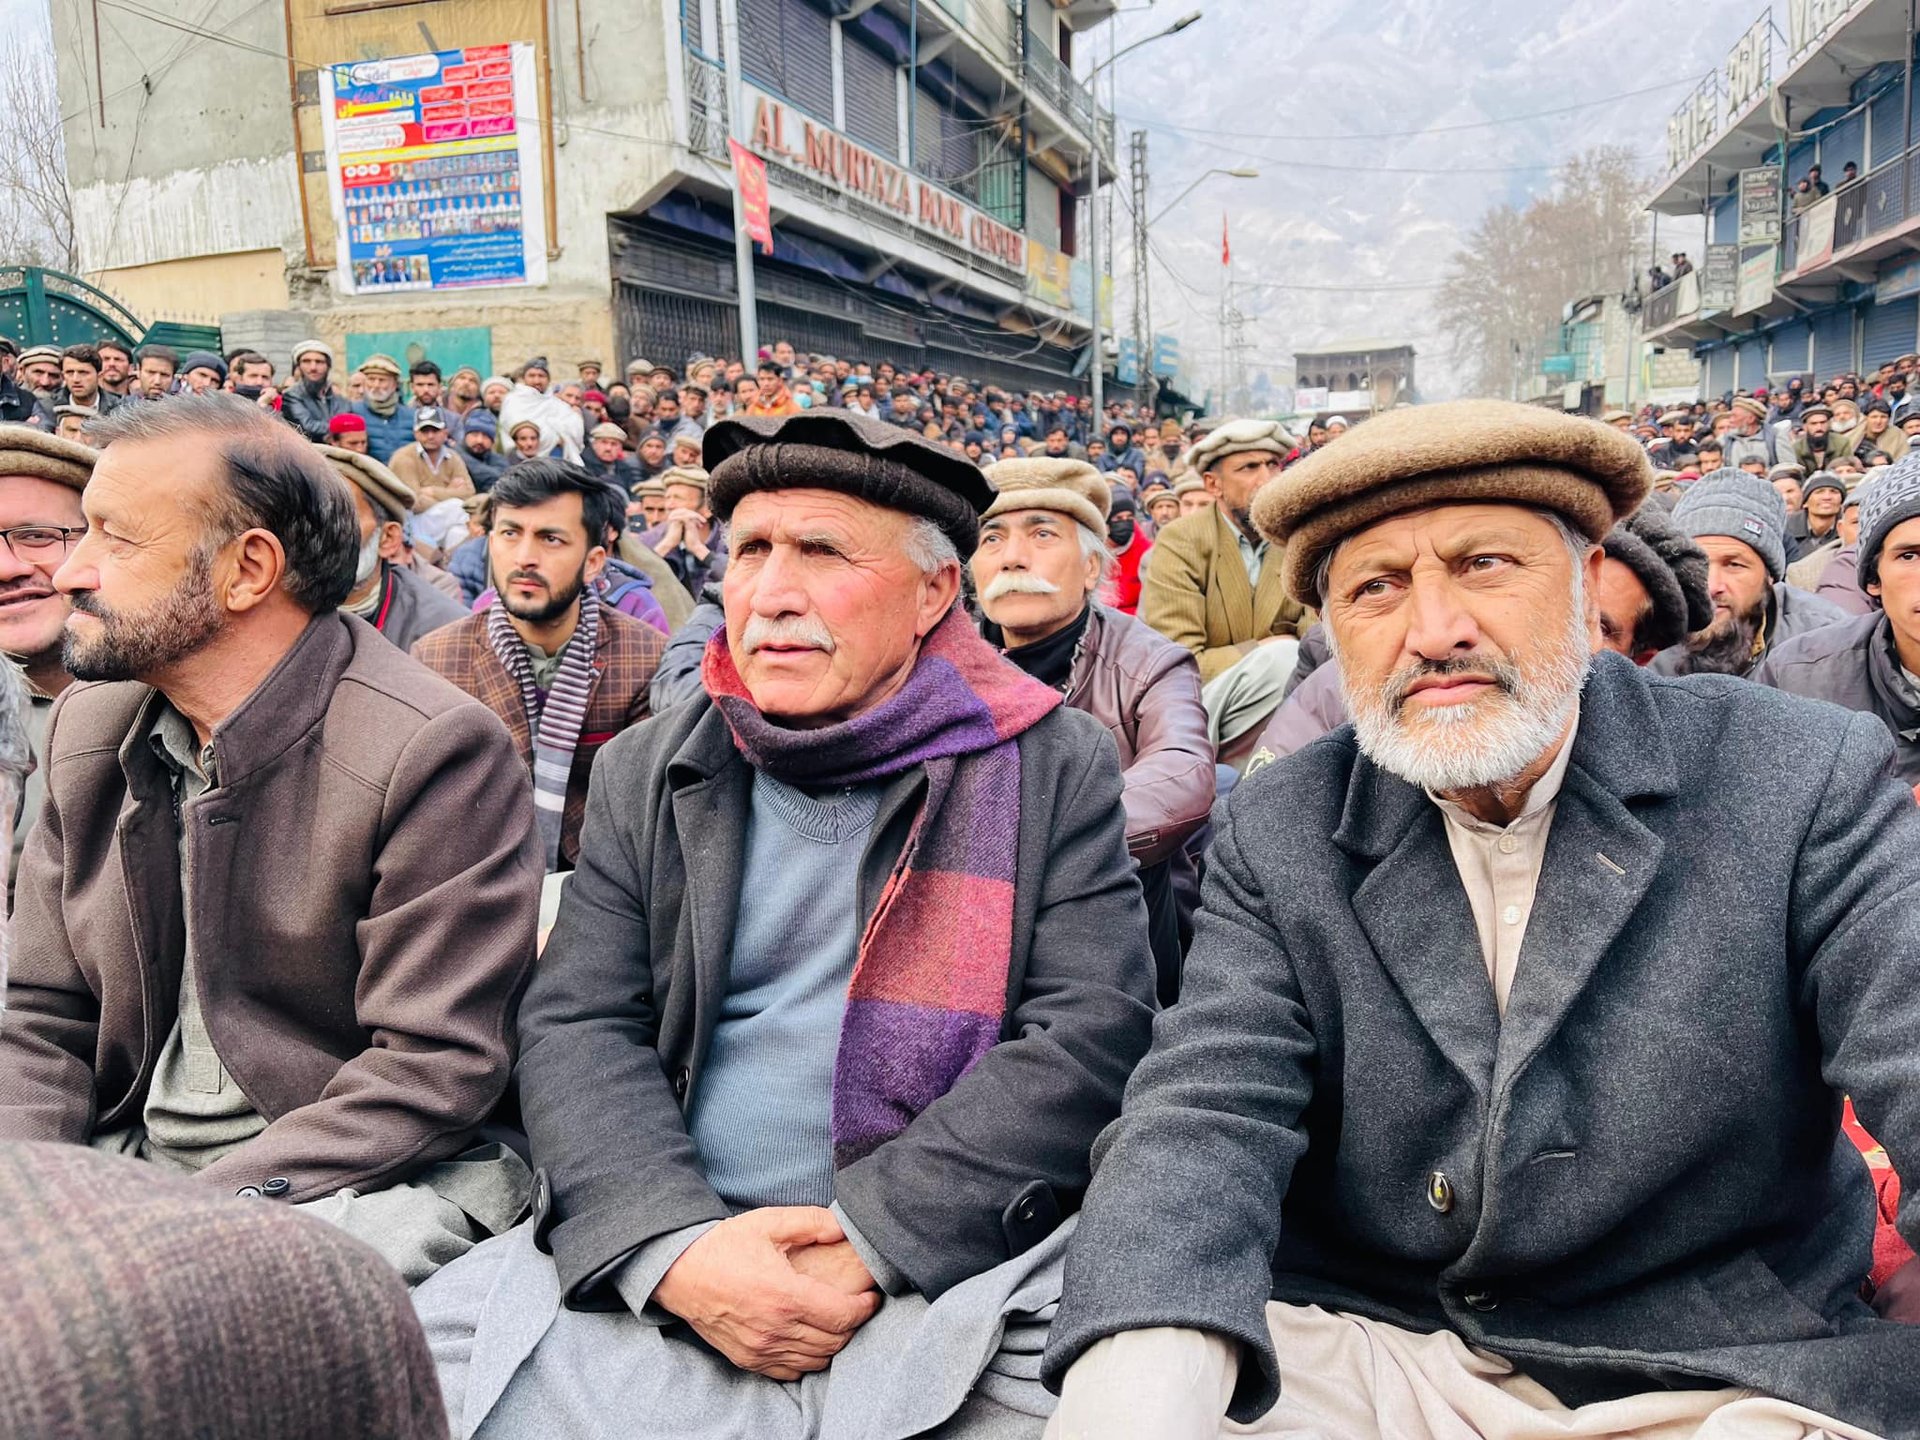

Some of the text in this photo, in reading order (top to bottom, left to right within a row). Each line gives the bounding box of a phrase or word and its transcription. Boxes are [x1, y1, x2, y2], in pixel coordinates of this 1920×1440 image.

[804, 121, 912, 215] MURTAZA
[919, 183, 964, 240] BOOK
[970, 212, 1022, 266] CENTER
